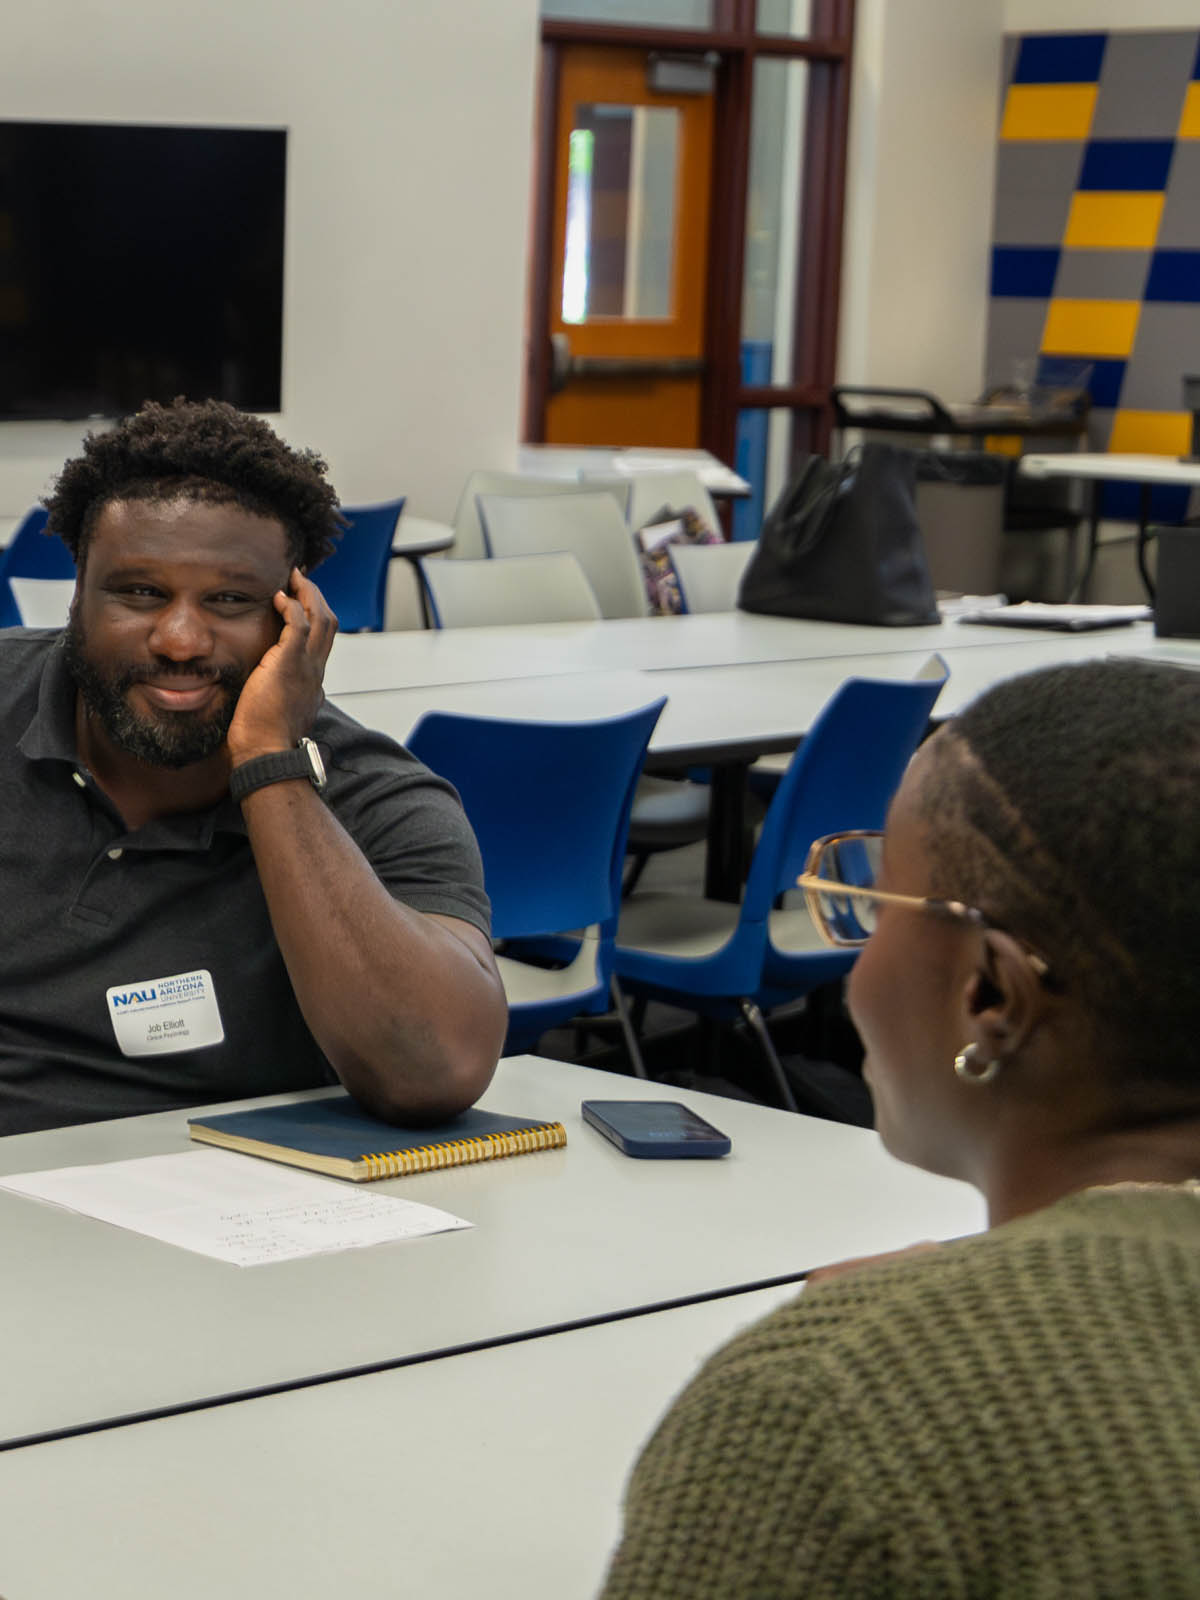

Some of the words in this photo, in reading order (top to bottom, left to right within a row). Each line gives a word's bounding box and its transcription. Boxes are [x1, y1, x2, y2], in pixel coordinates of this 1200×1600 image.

[158, 975, 202, 989] NORTHERN
[160, 981, 204, 996] ARIZONA
[113, 989, 156, 1007] NAU
[147, 1023, 162, 1034] Job
